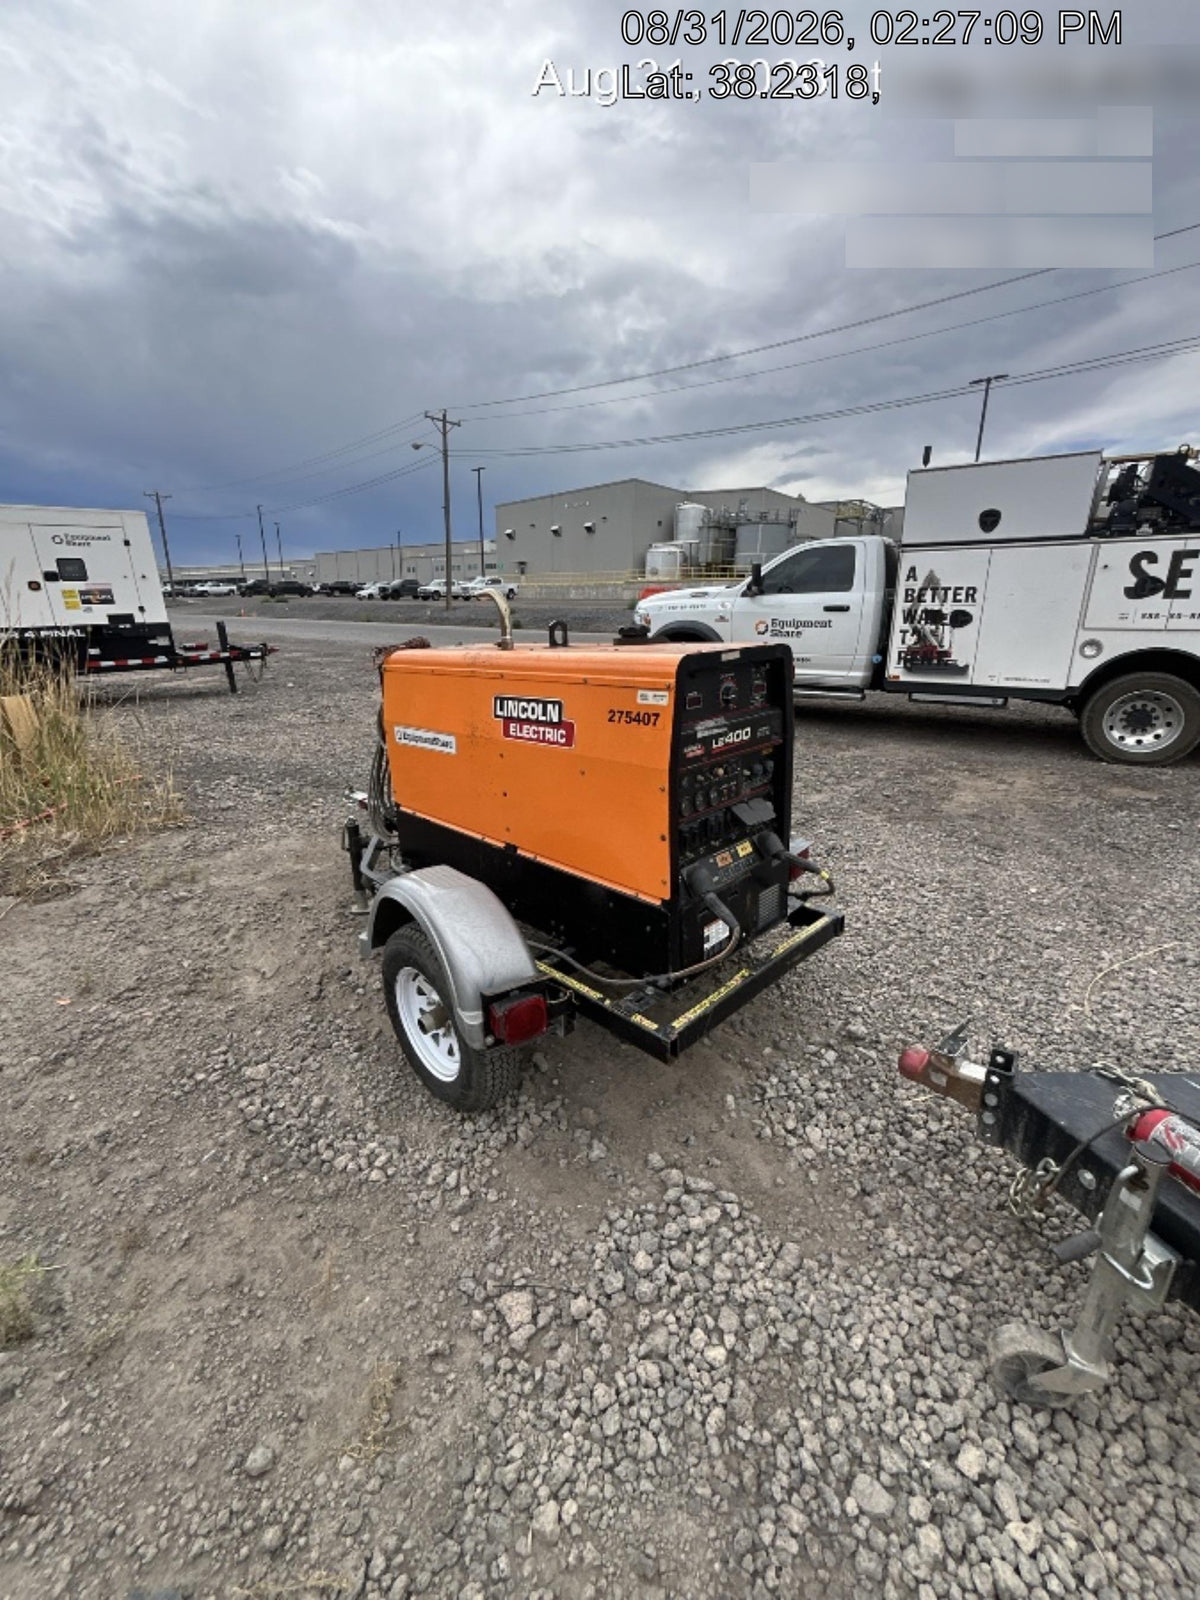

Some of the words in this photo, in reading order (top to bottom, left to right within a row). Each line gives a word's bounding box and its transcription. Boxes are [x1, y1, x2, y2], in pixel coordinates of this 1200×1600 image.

[905, 565, 918, 582] A
[903, 586, 978, 603] BETTER
[771, 617, 833, 630] Equipment
[769, 628, 803, 639] Share
[495, 698, 559, 723] LINCOLN
[607, 708, 660, 727] 275407
[509, 723, 567, 744] ELECTRIC
